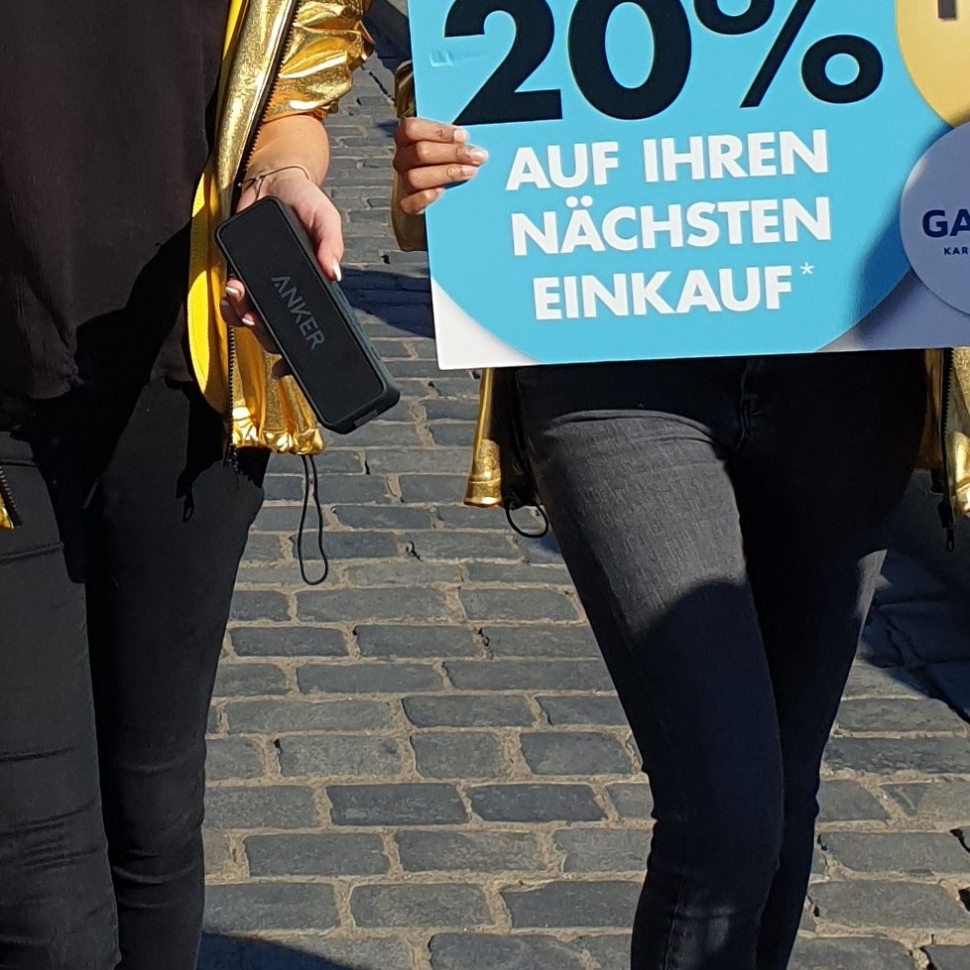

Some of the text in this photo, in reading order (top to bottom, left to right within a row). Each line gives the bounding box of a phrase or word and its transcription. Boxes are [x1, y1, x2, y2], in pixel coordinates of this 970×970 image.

[506, 129, 828, 191] AUF IHREN
[511, 196, 832, 256] NÄCHSTEN
[270, 276, 326, 350] ANKER
